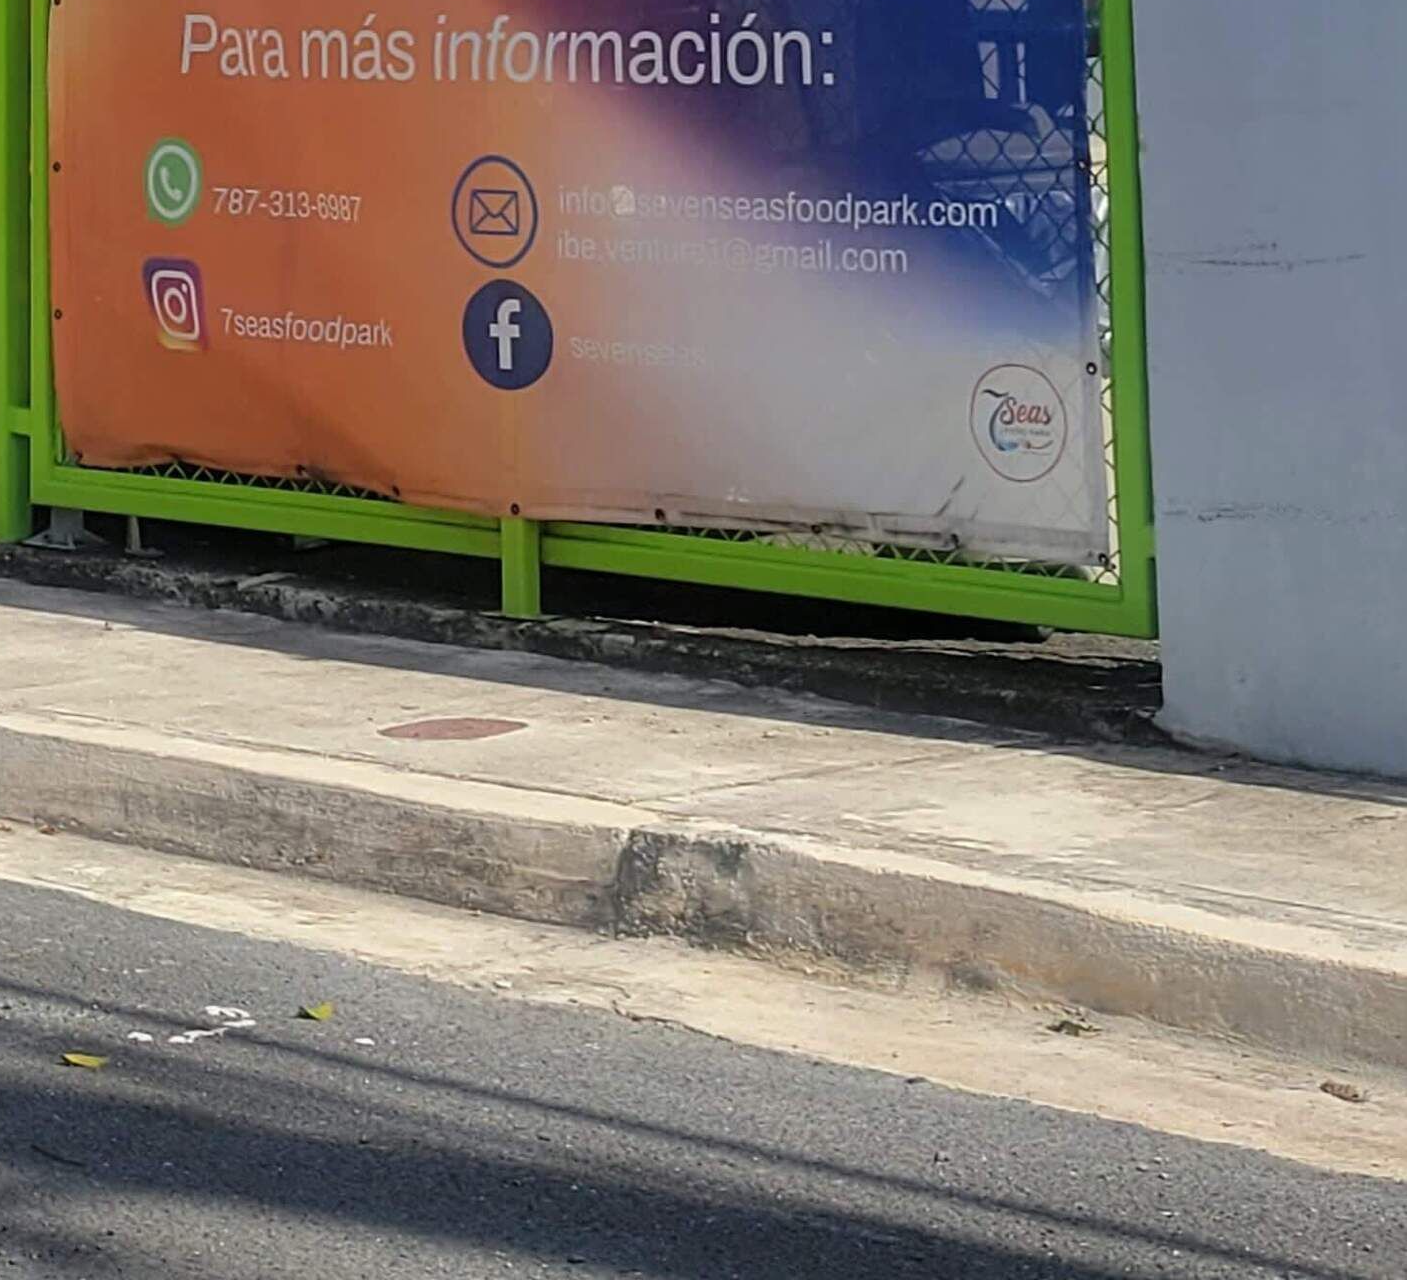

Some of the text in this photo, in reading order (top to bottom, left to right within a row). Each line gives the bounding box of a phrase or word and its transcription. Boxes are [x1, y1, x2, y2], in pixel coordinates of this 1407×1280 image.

[180, 12, 836, 87] Para más información:
[212, 187, 362, 224] 787-313-6987
[219, 307, 393, 350] 7seasfoodpark
[999, 396, 1055, 426] Seas
